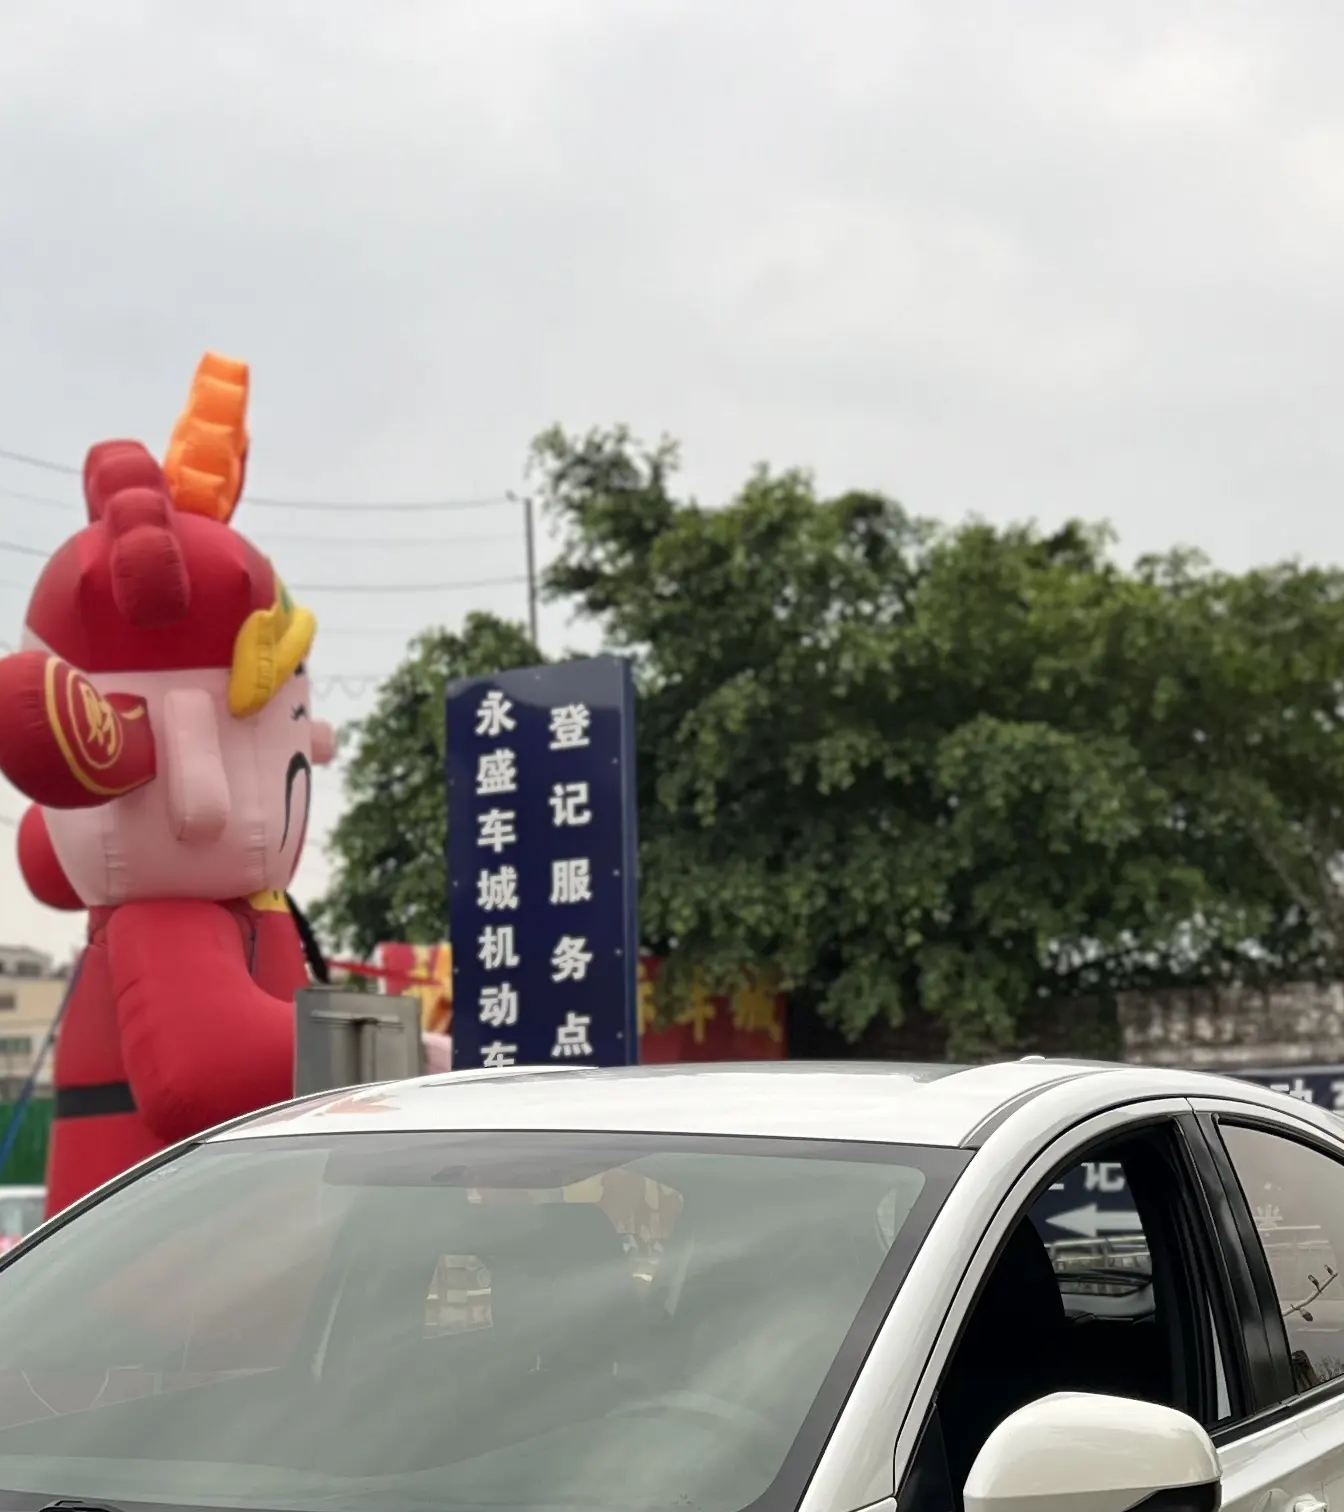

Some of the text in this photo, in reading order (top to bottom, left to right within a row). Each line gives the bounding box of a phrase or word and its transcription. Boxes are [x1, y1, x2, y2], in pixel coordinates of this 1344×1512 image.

[548, 703, 594, 1058] 登记服务点
